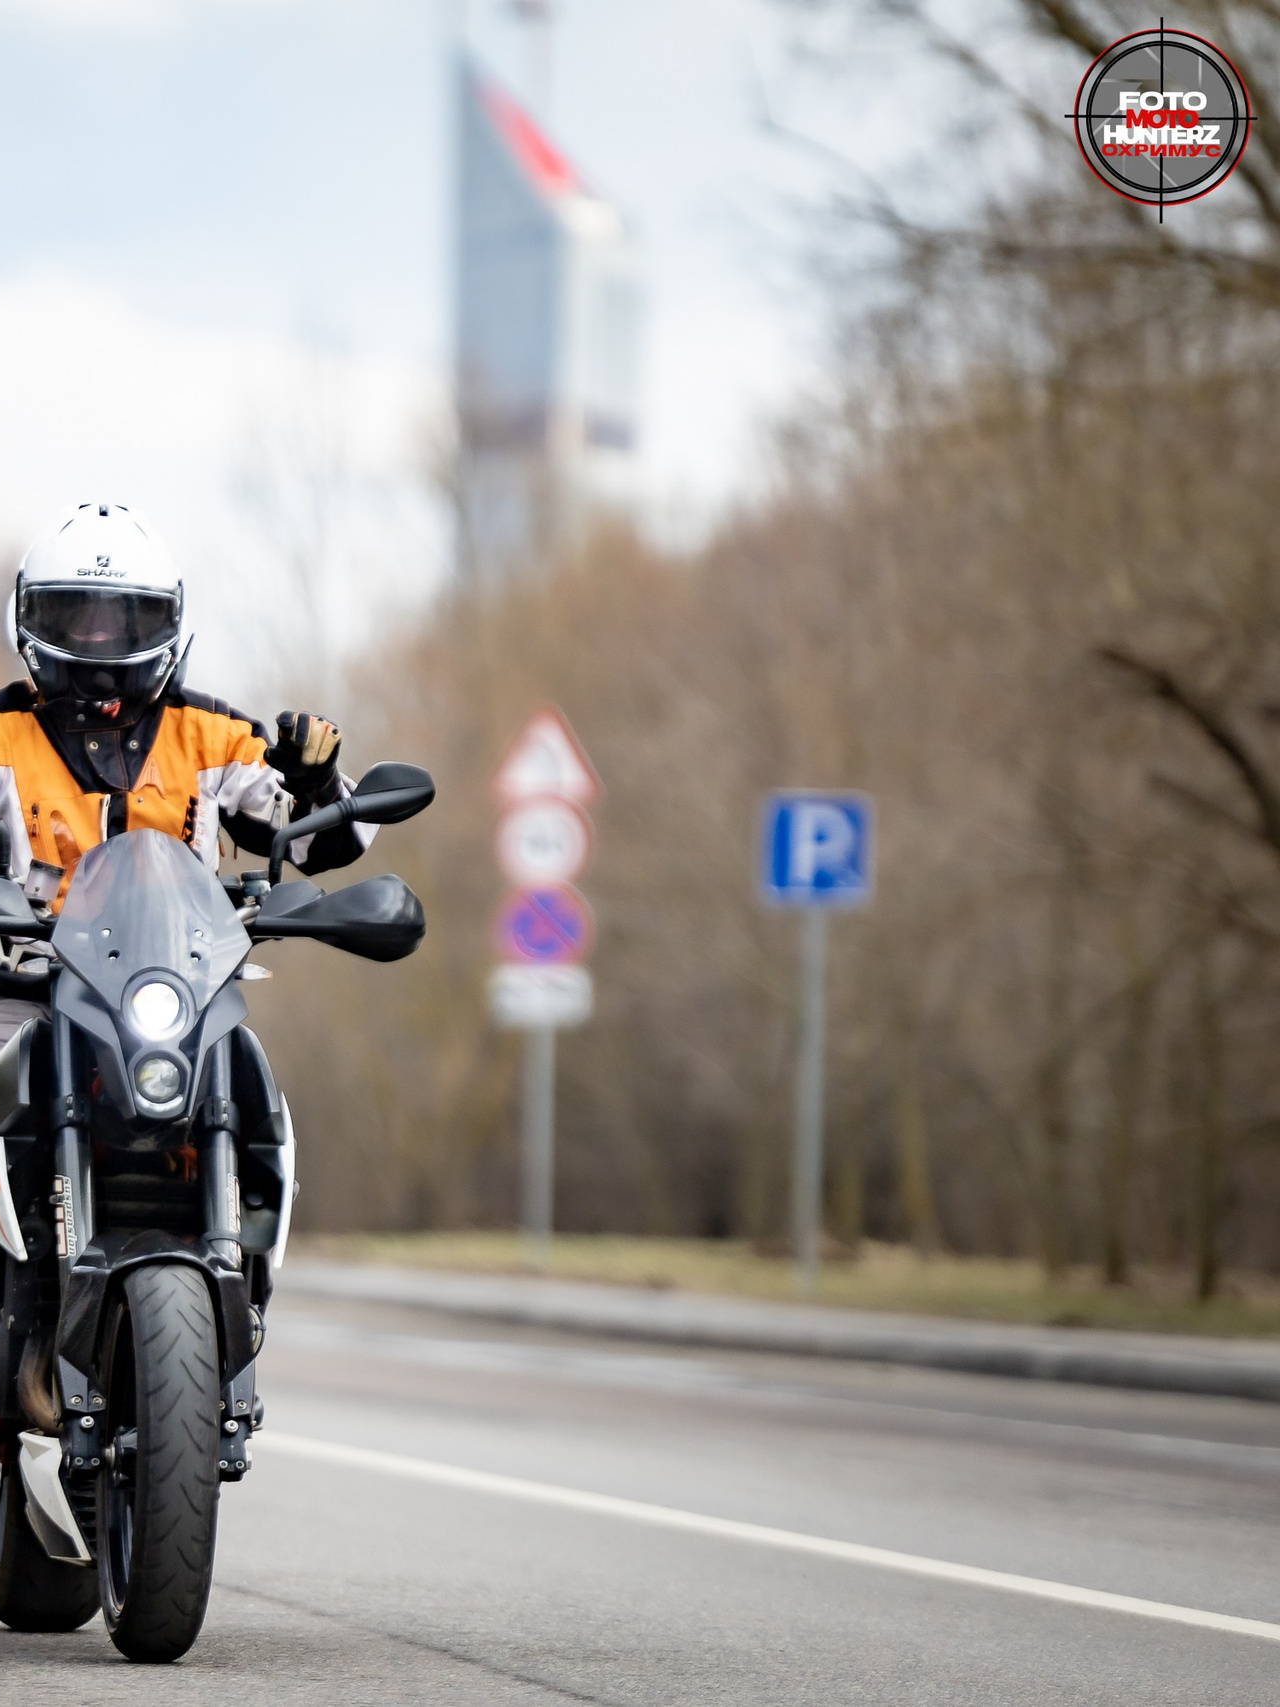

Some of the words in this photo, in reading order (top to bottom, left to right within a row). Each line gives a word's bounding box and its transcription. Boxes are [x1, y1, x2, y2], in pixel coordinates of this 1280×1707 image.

[77, 568, 127, 578] SHARK
[796, 803, 852, 882] P
[63, 1177, 77, 1256] suspension
